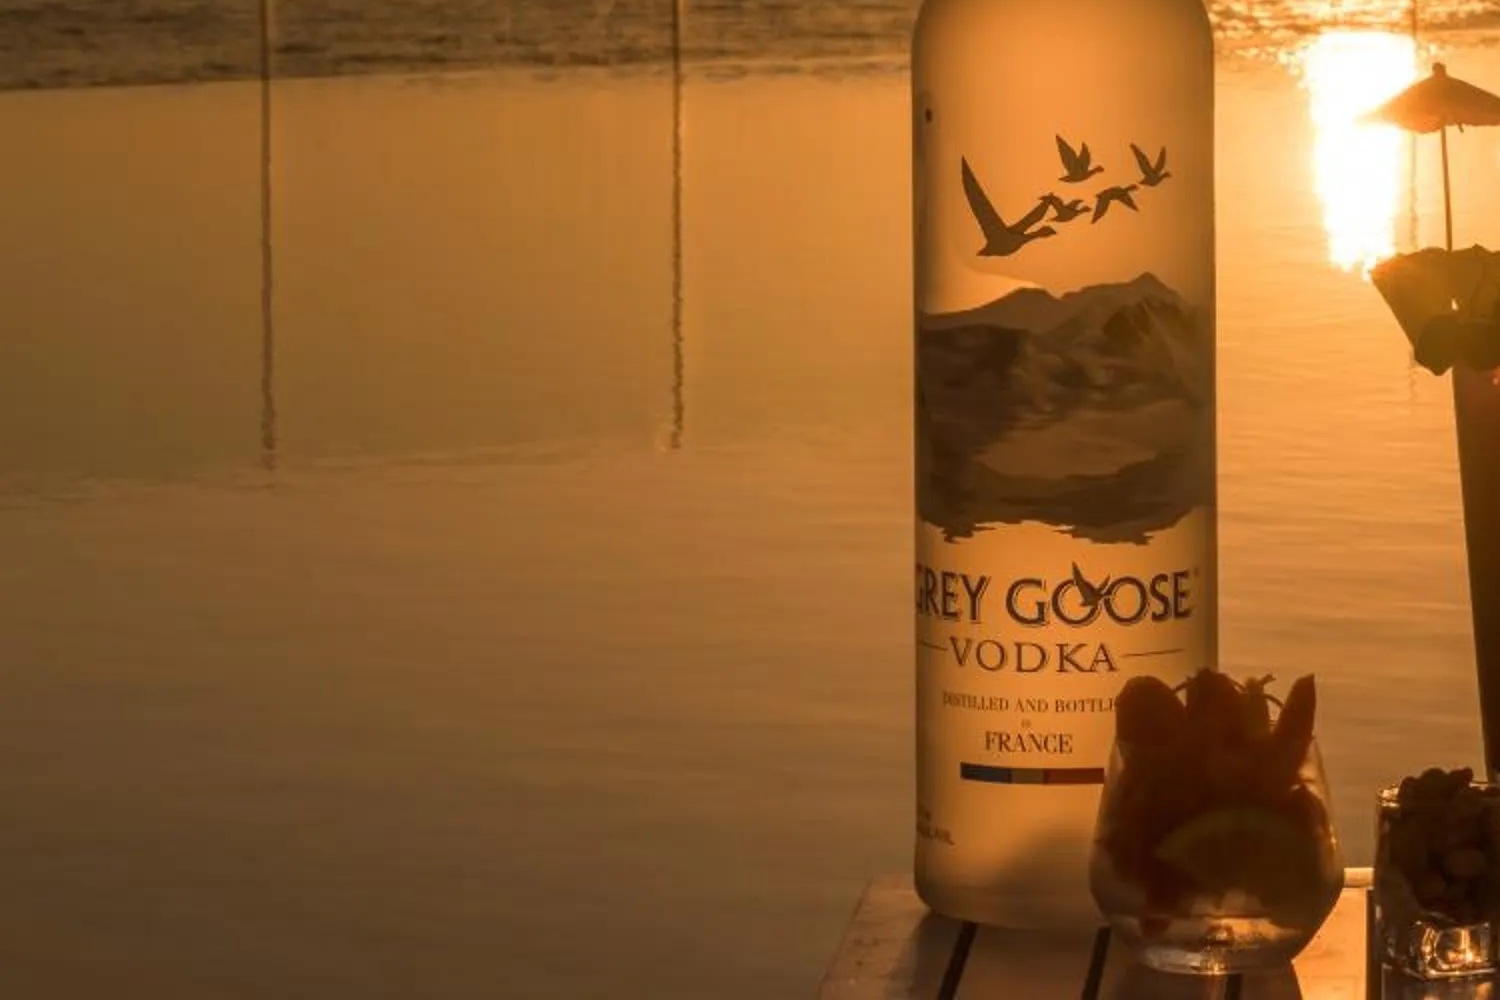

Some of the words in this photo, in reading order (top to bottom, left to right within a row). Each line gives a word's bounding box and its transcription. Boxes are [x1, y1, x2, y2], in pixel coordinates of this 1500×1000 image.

[1006, 570, 1194, 627] GOOSE
[949, 636, 1118, 673] VODKA
[942, 690, 1010, 712] DISTILLED
[1016, 697, 1049, 713] AND
[984, 730, 1074, 754] FRANCE
